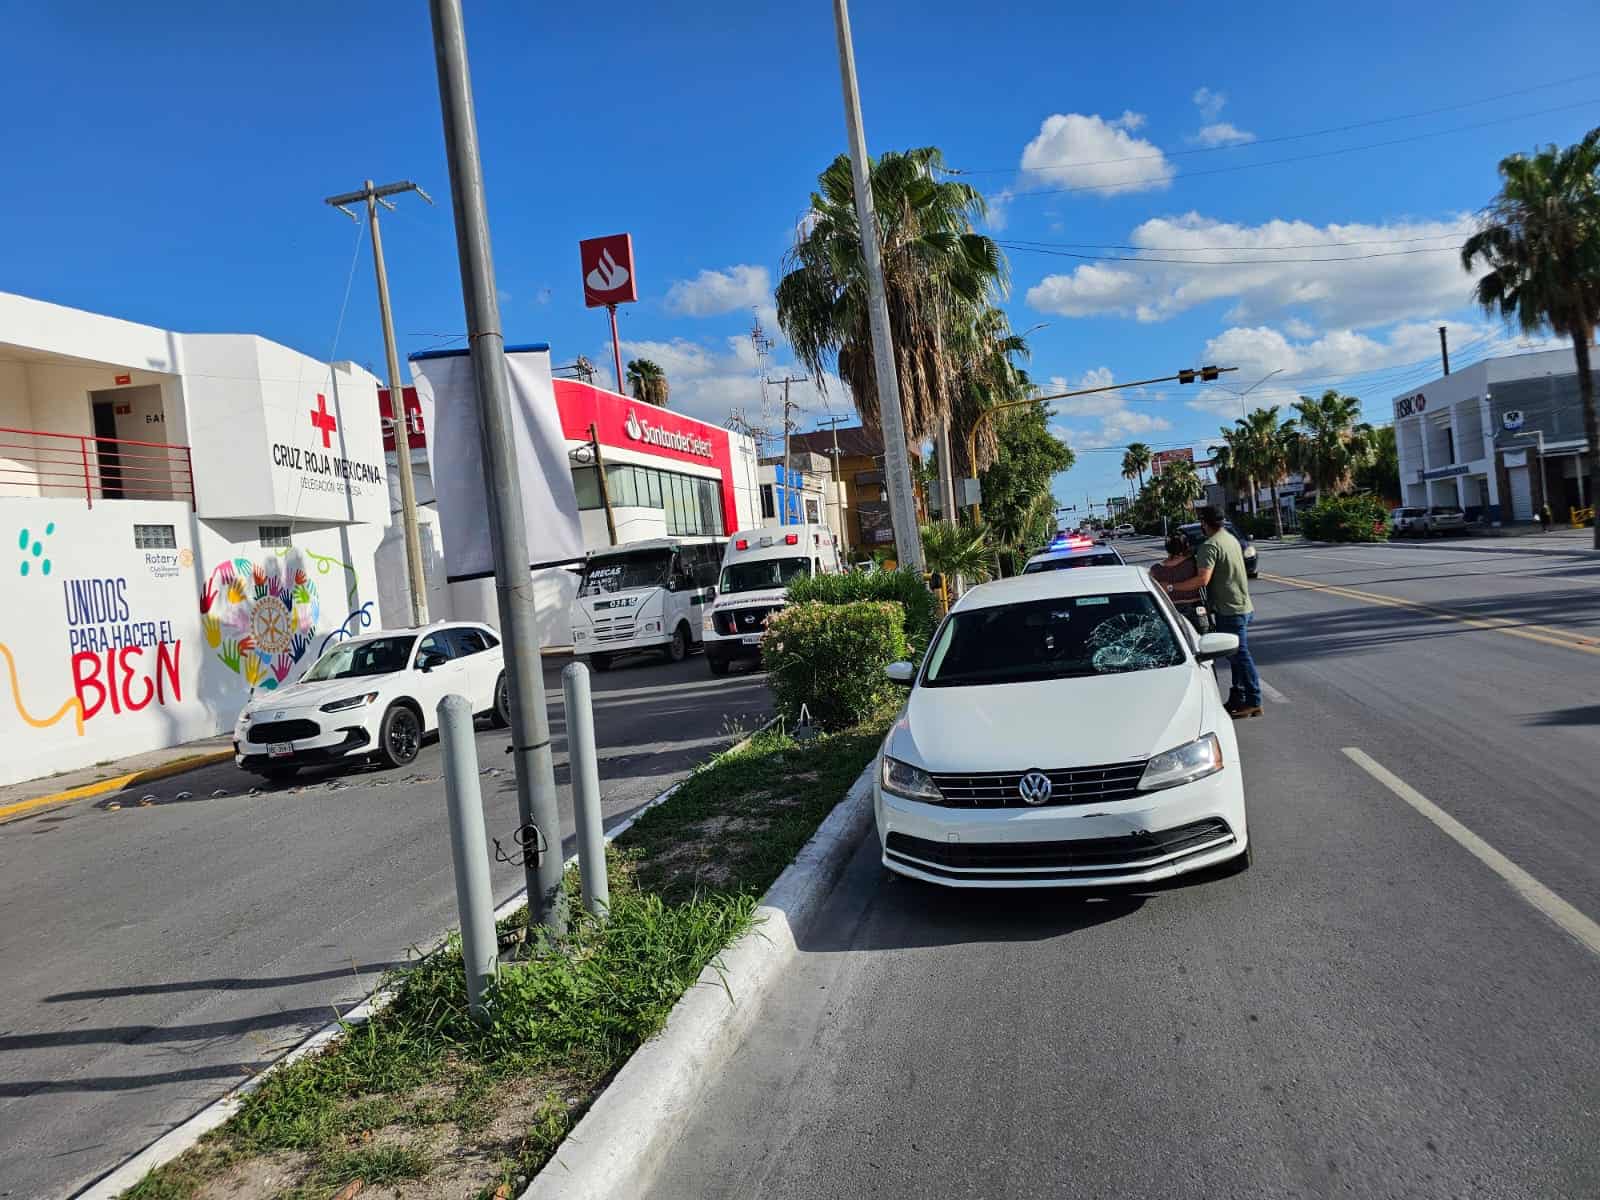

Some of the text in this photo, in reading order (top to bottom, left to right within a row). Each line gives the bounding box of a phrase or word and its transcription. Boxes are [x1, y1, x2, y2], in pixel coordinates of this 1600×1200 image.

[641, 419, 713, 459] Santander Select
[273, 443, 381, 485] CRUZ ROJA MEXICANA
[145, 552, 178, 566] Rotary
[64, 577, 129, 626] UNIDOS
[69, 620, 175, 655] PARA HACER EL
[71, 639, 181, 721] BIEN
